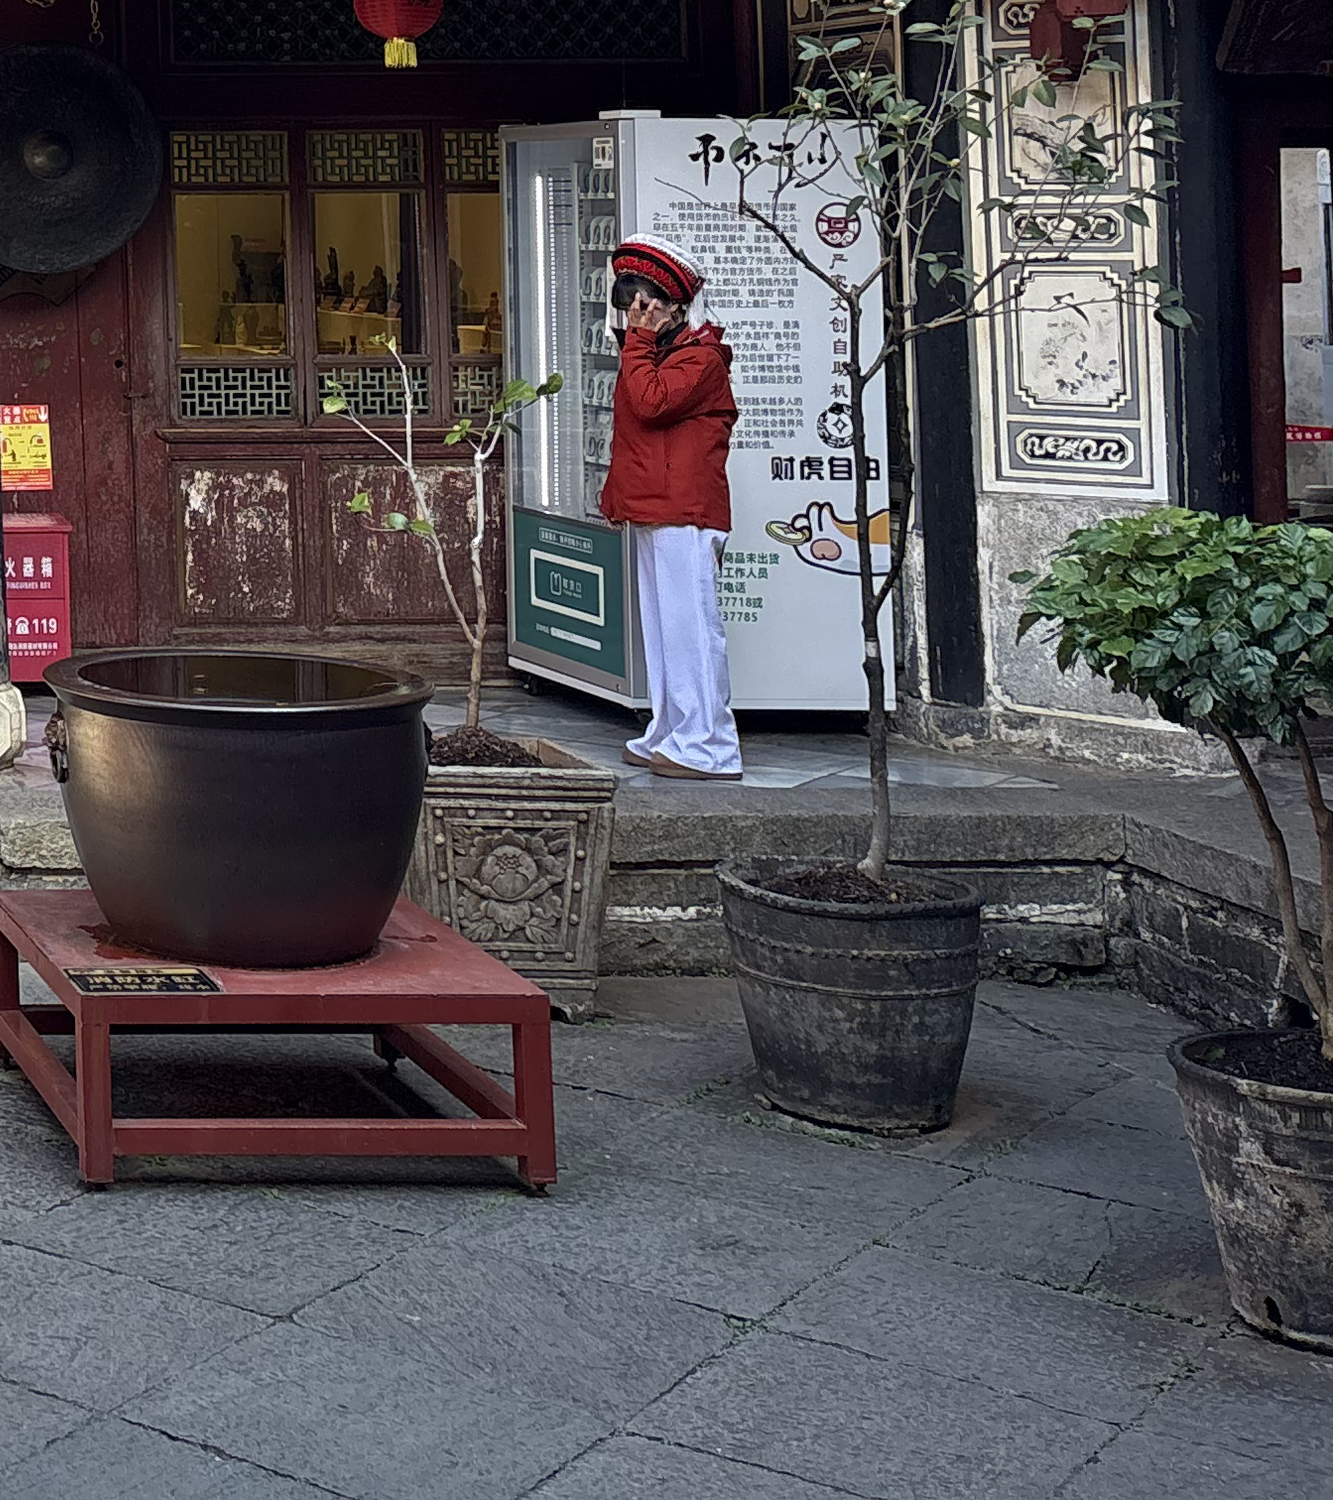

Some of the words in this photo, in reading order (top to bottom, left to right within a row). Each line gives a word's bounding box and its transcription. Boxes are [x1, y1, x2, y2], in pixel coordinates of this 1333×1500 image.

[829, 253, 849, 398] 严家文创自助机
[5, 556, 53, 578] 火器箱
[718, 567, 768, 579] 工作人员
[718, 611, 758, 622] 37785
[32, 617, 58, 634] 119
